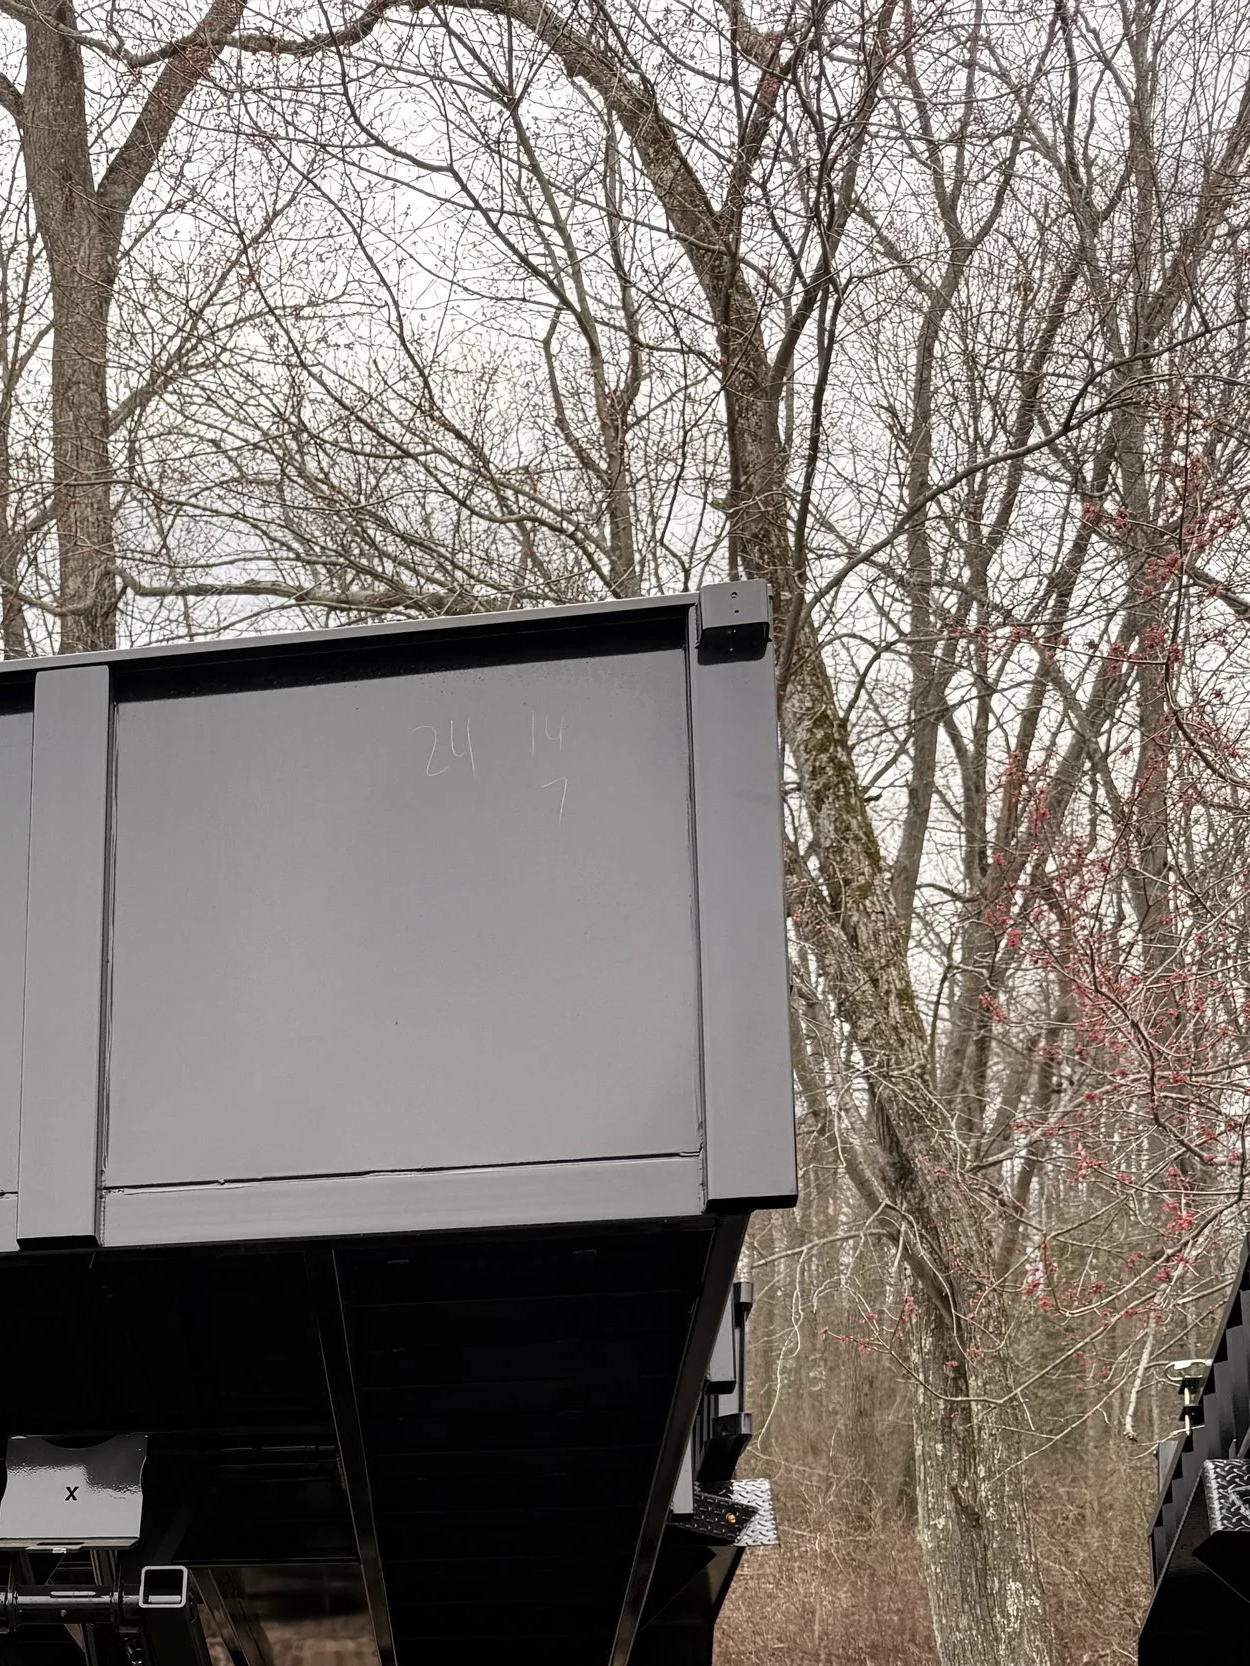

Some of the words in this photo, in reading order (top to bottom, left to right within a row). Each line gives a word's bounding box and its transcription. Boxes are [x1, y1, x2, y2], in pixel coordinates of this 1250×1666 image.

[412, 717, 476, 778] 24
[530, 710, 566, 757] 14
[65, 1486, 79, 1501] X
